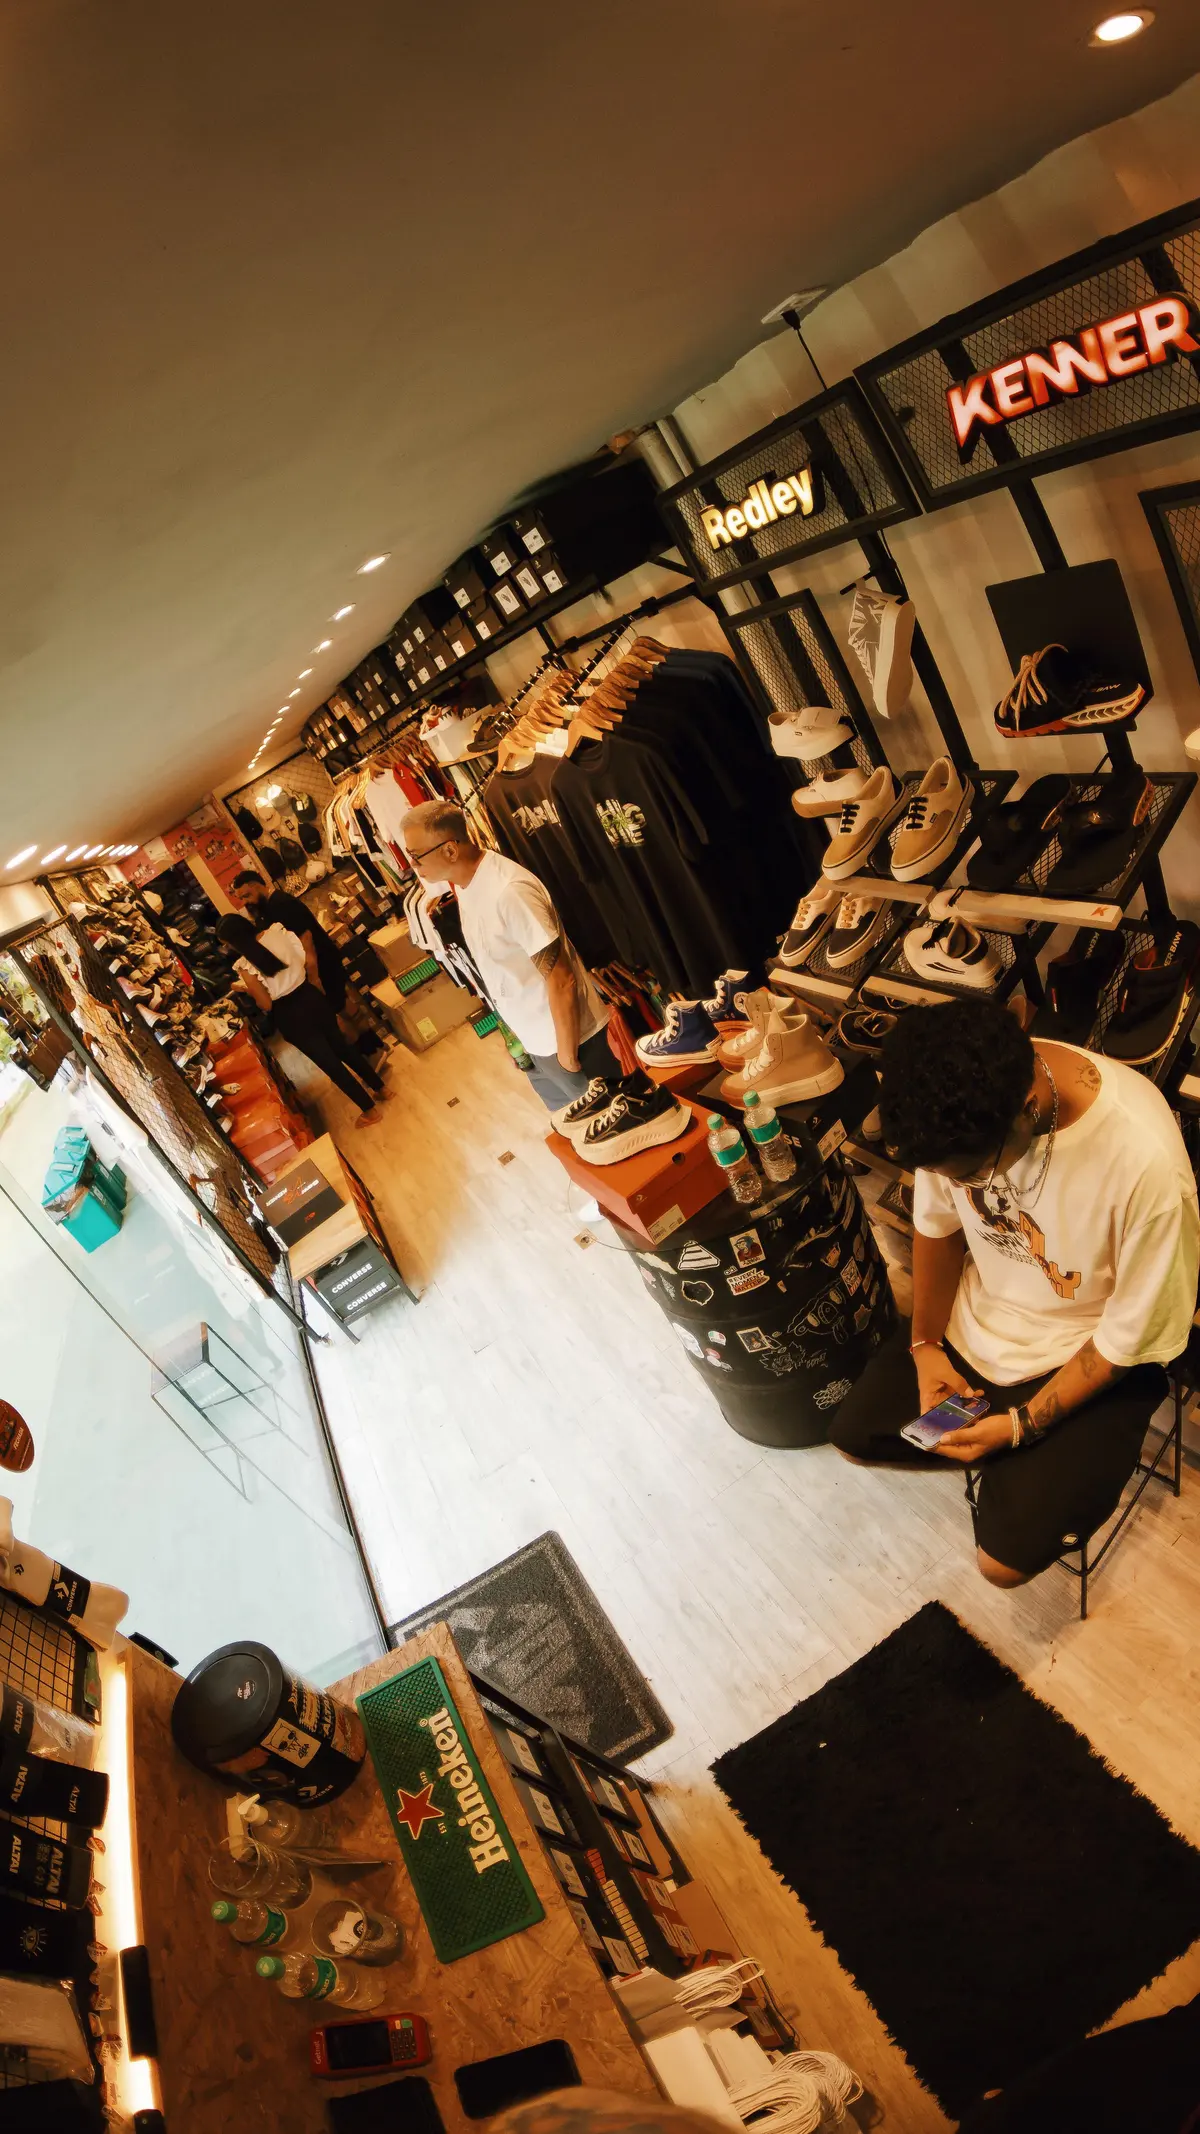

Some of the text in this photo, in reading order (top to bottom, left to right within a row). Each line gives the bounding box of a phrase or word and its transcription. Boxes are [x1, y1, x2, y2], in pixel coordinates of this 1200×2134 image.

[946, 297, 1200, 448] KENNER
[700, 468, 814, 550] Redley
[331, 1263, 373, 1294] CONVERSE
[346, 1281, 388, 1311] CONVERSE
[731, 1272, 763, 1287] MOMENT
[66, 1580, 78, 1612] CONVERSE
[14, 1700, 25, 1735] ALTAI
[10, 1765, 29, 1803] ALTAI
[68, 1785, 80, 1814] ALTAI
[428, 1707, 511, 1875] Heineken
[9, 1834, 22, 1875] ALTAI
[46, 1845, 64, 1895] ALTAI
